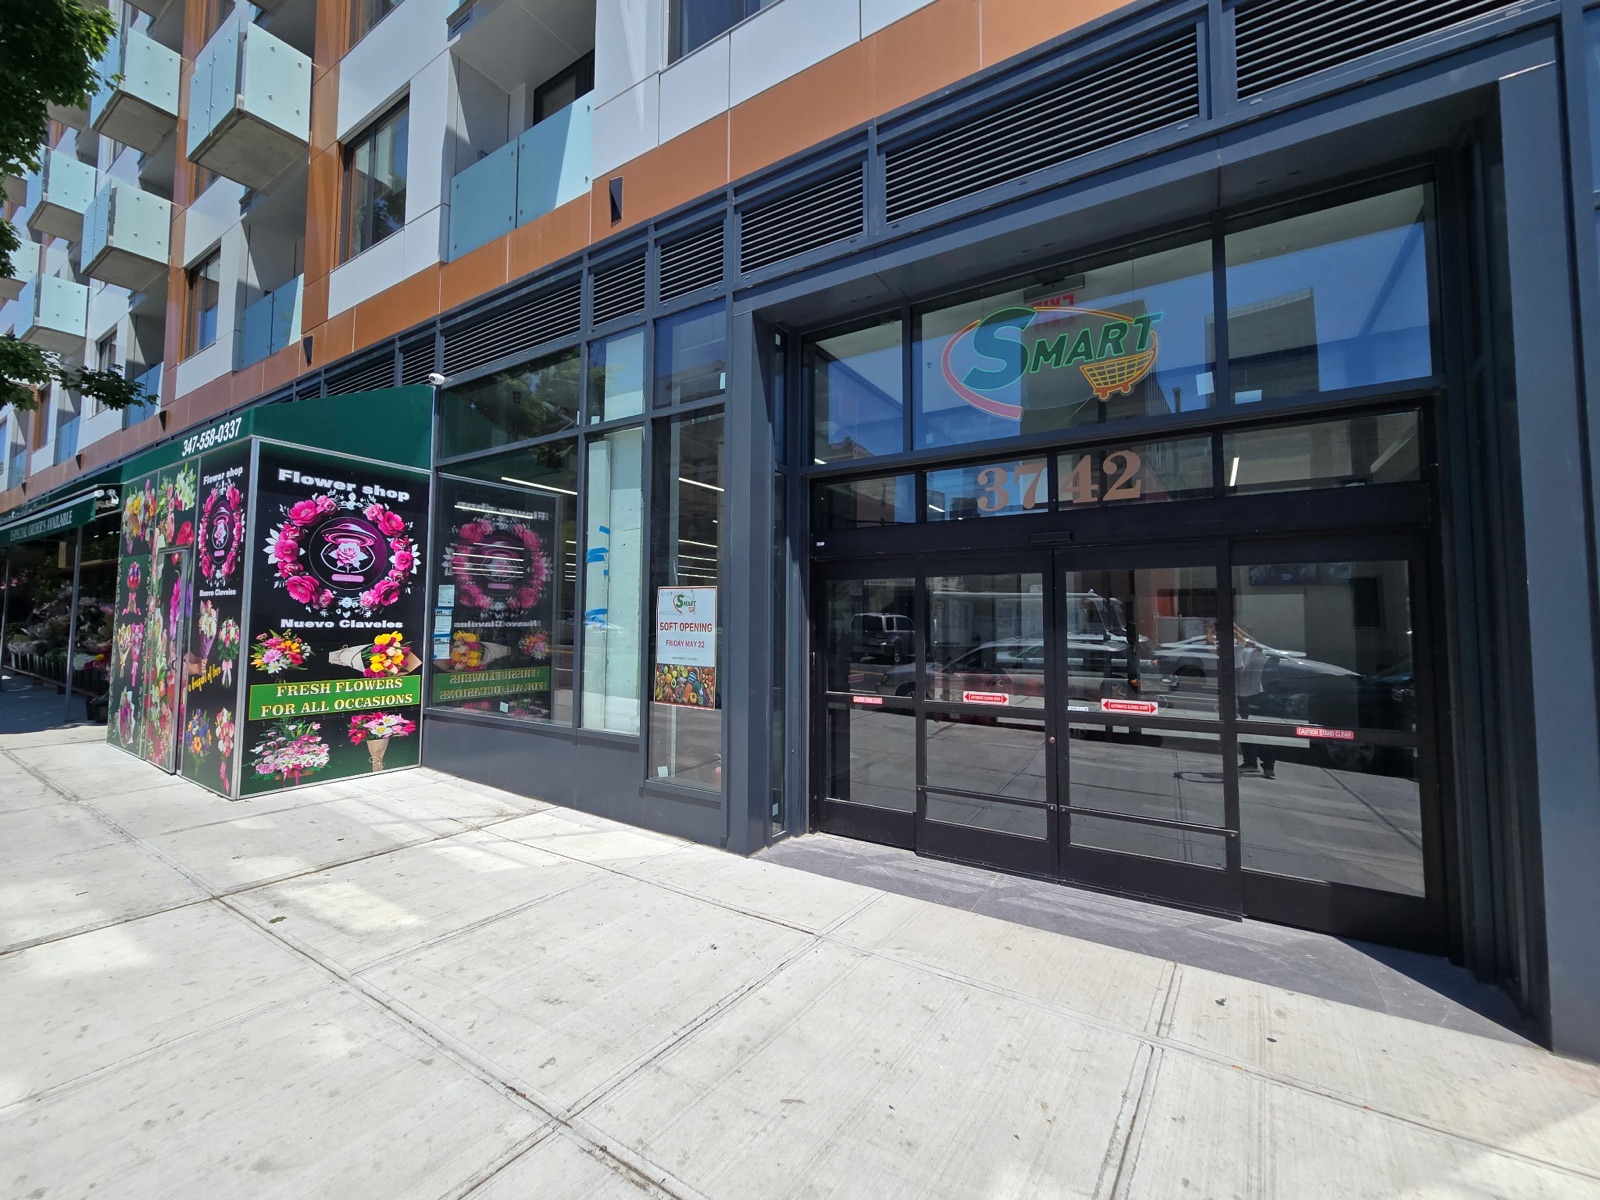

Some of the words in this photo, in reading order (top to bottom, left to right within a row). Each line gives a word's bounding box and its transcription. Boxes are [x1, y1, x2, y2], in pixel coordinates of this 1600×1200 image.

[182, 417, 242, 457] 347-558-0337
[203, 472, 225, 485] Flower
[225, 466, 243, 478] shop
[278, 468, 357, 491] Flower
[362, 484, 410, 502] shop
[977, 450, 1142, 512] 3742
[280, 619, 335, 629] Nuevo
[339, 619, 404, 629] Claveles
[660, 622, 678, 632] SOFT
[679, 622, 713, 633] OPENING
[665, 639, 684, 647] FRIDAY
[685, 640, 697, 648] MAY
[698, 641, 705, 649] 22
[276, 683, 331, 698] FRESH
[335, 678, 403, 693] FLOWERS
[261, 703, 296, 717] FOR
[300, 701, 330, 714] ALL
[334, 693, 413, 710] OCCASIONS
